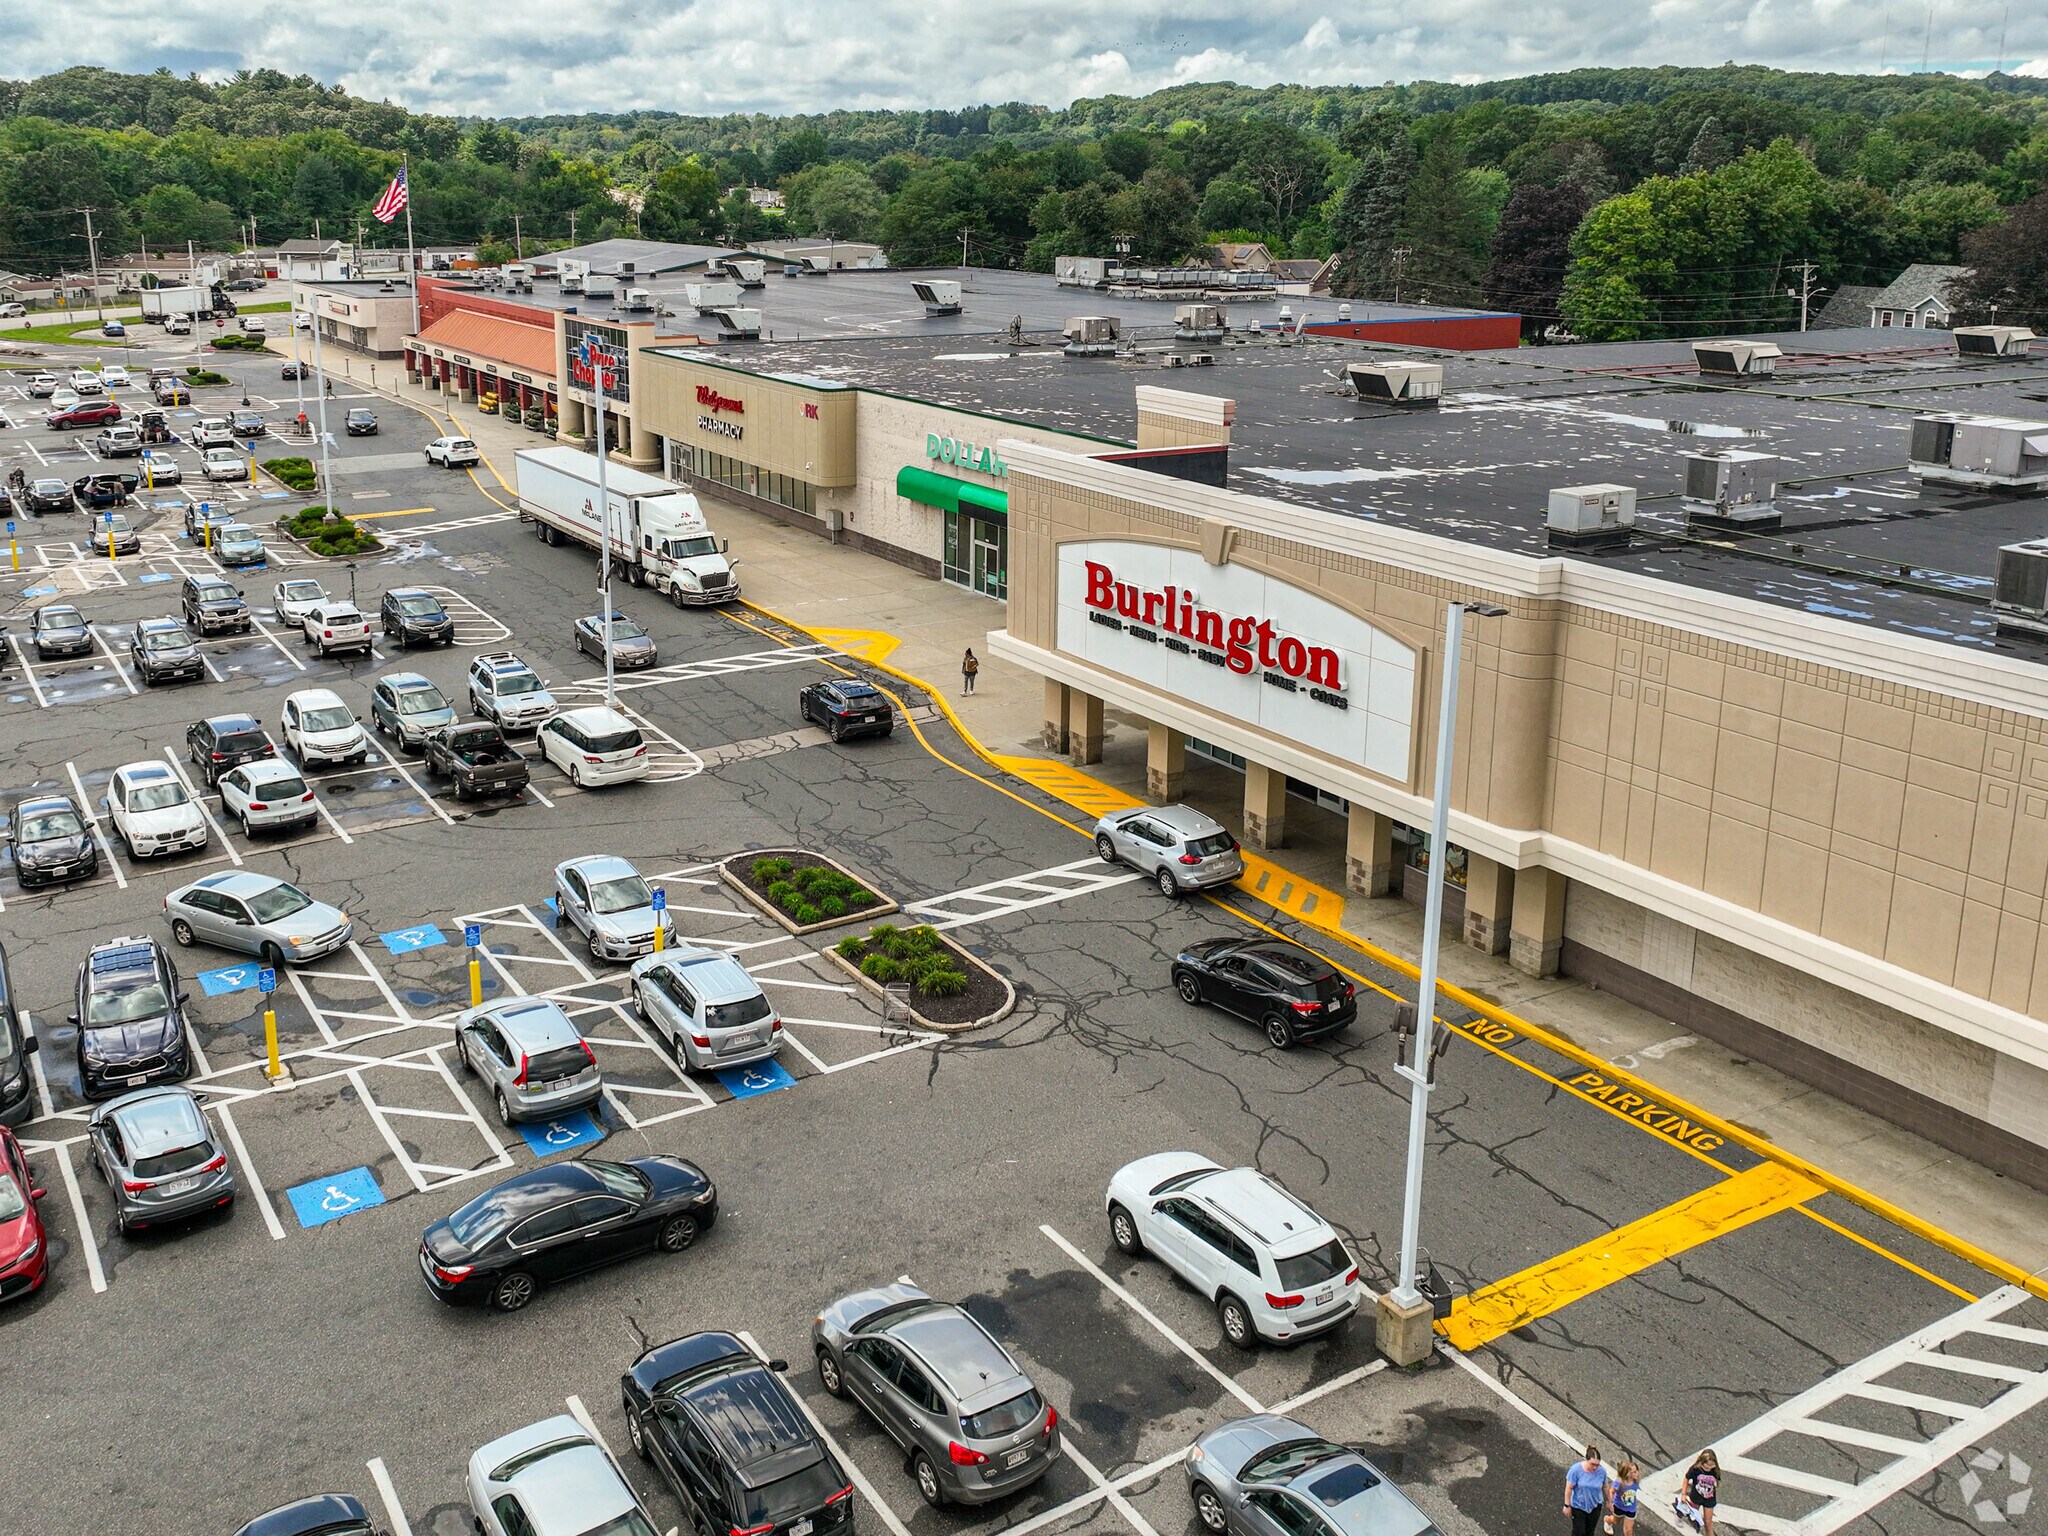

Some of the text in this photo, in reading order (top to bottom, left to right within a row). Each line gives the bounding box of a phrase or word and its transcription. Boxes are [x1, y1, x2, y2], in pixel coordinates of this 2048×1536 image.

[698, 416, 743, 440] PHARMACY
[805, 403, 819, 420] RK
[1085, 560, 1344, 691] Burlington
[1089, 611, 1348, 709] LADIES MENS KIDS BABY HOME COATS
[1462, 1018, 1724, 1151] NO PARKING
